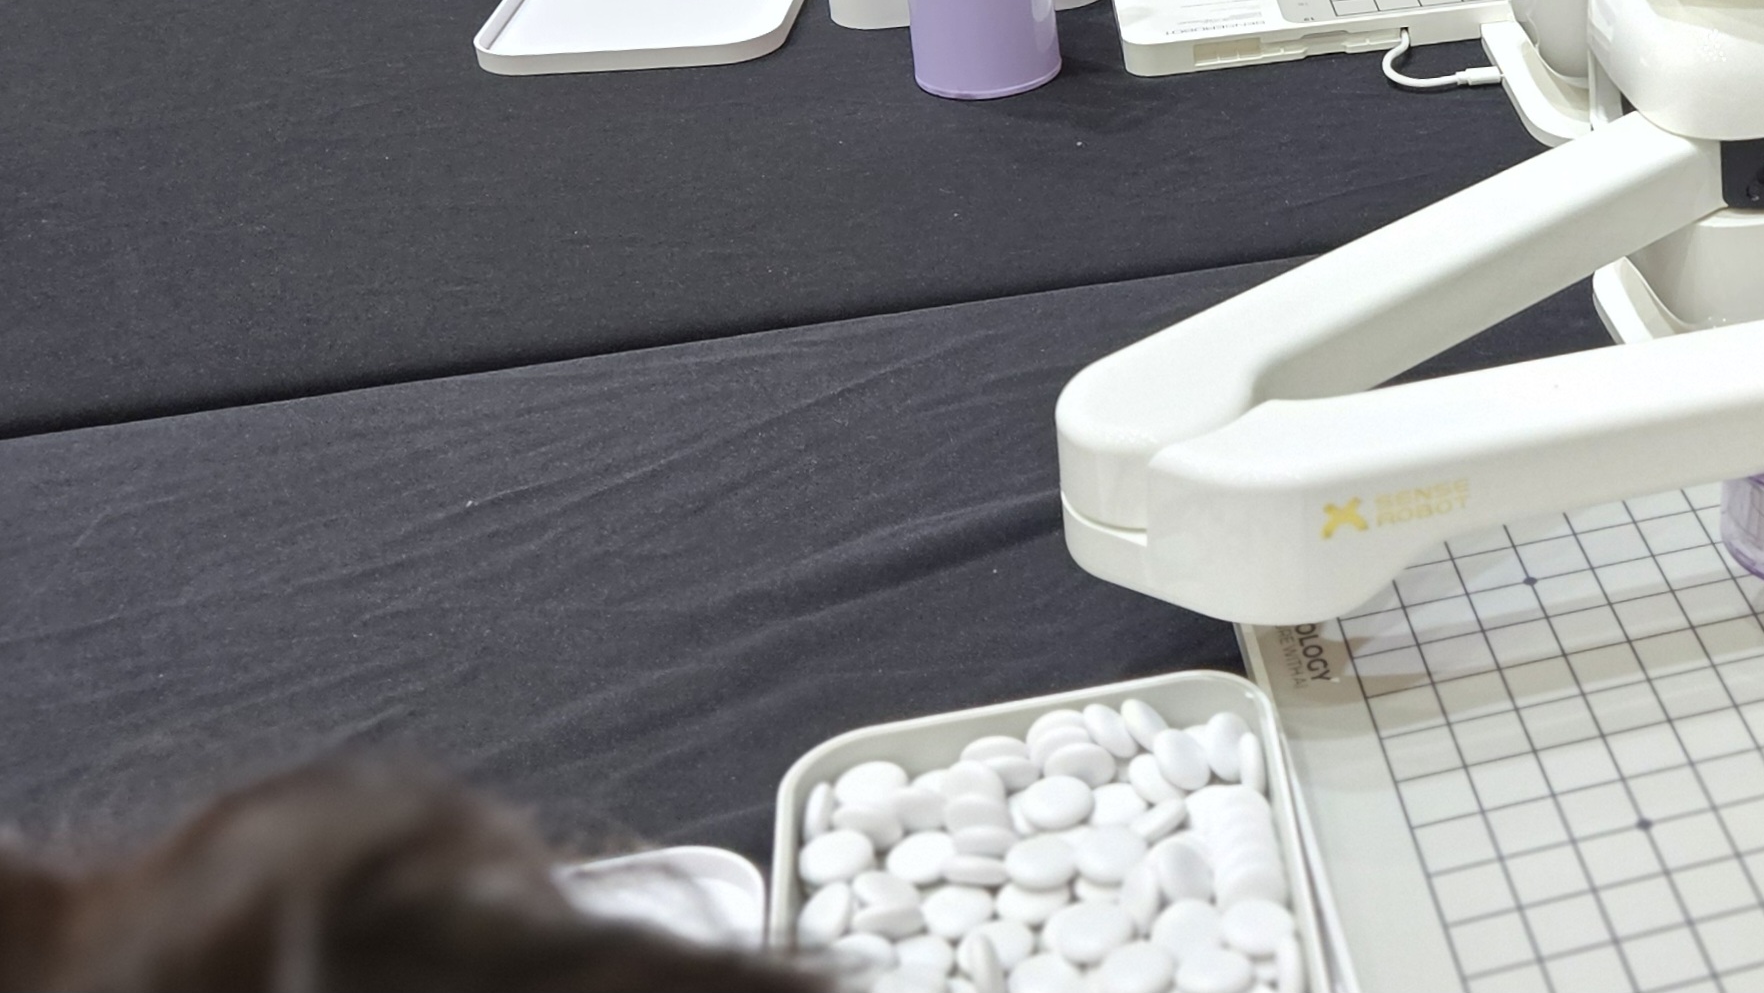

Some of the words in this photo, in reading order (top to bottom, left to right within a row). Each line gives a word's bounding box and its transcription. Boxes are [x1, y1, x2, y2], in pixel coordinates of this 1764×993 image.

[1373, 477, 1469, 506] SENSE
[1376, 493, 1469, 527] ROBOT
[1282, 646, 1306, 677] WITH
